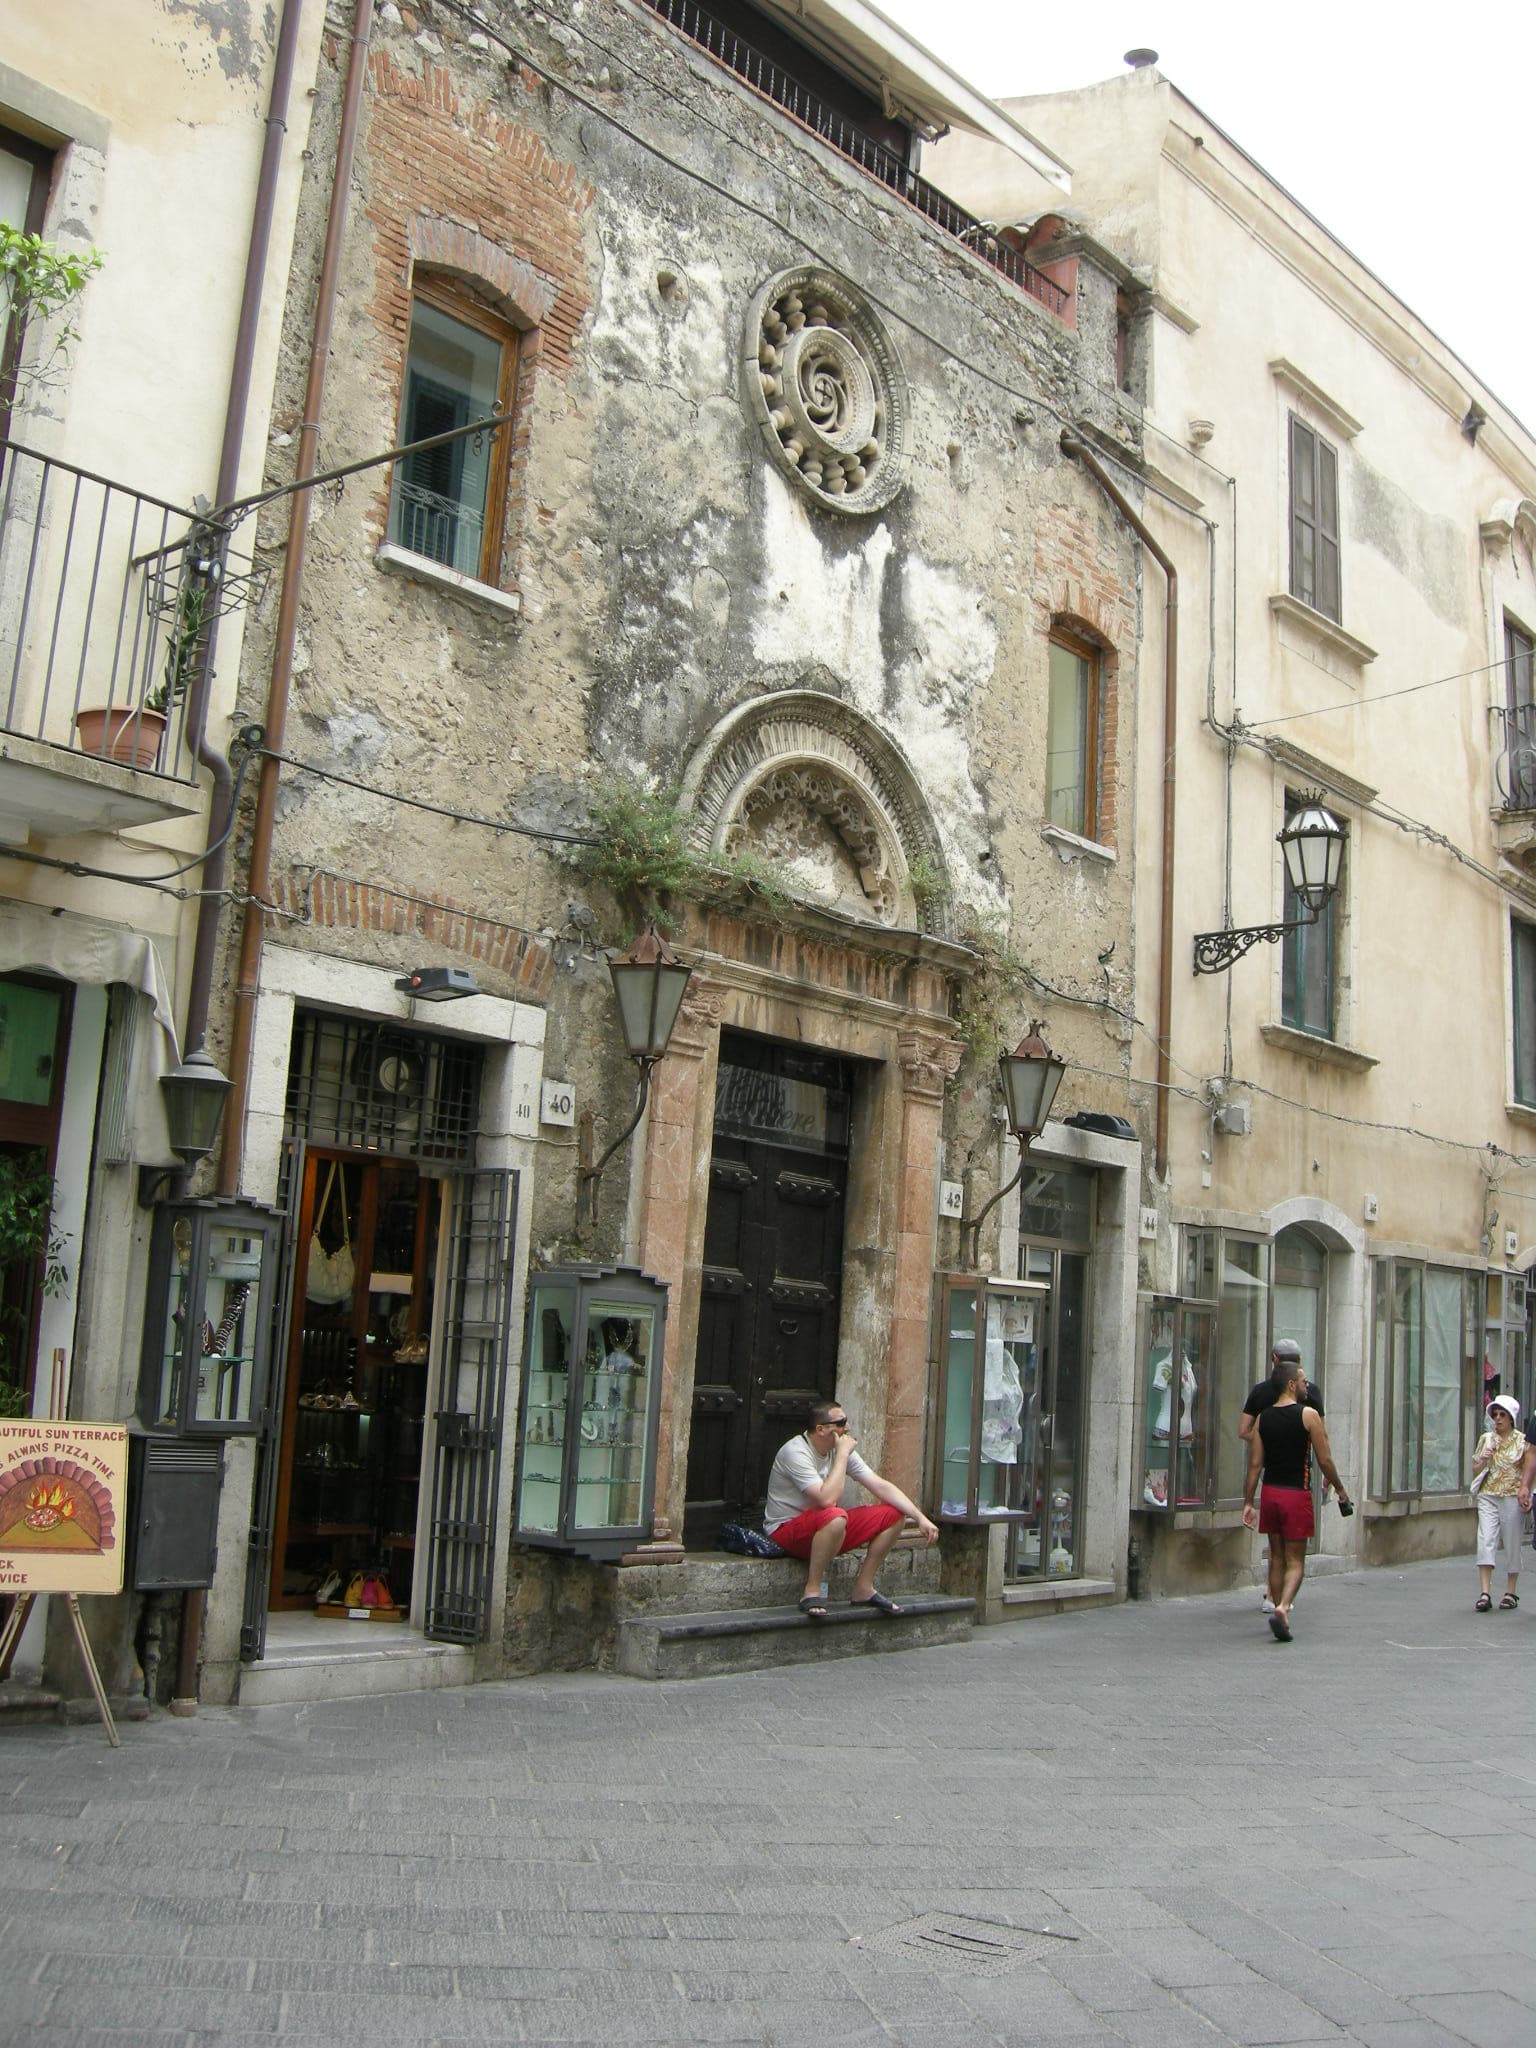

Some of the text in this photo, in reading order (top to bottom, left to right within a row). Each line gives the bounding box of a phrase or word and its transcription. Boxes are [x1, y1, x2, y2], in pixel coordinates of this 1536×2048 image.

[549, 1094, 571, 1114] 40
[946, 1191, 961, 1209] 42
[1144, 1216, 1155, 1231] 44
[45, 1429, 70, 1439] SUN
[73, 1430, 124, 1441] TERRACE
[7, 1442, 115, 1480] ALWAYS PIZZA TIME
